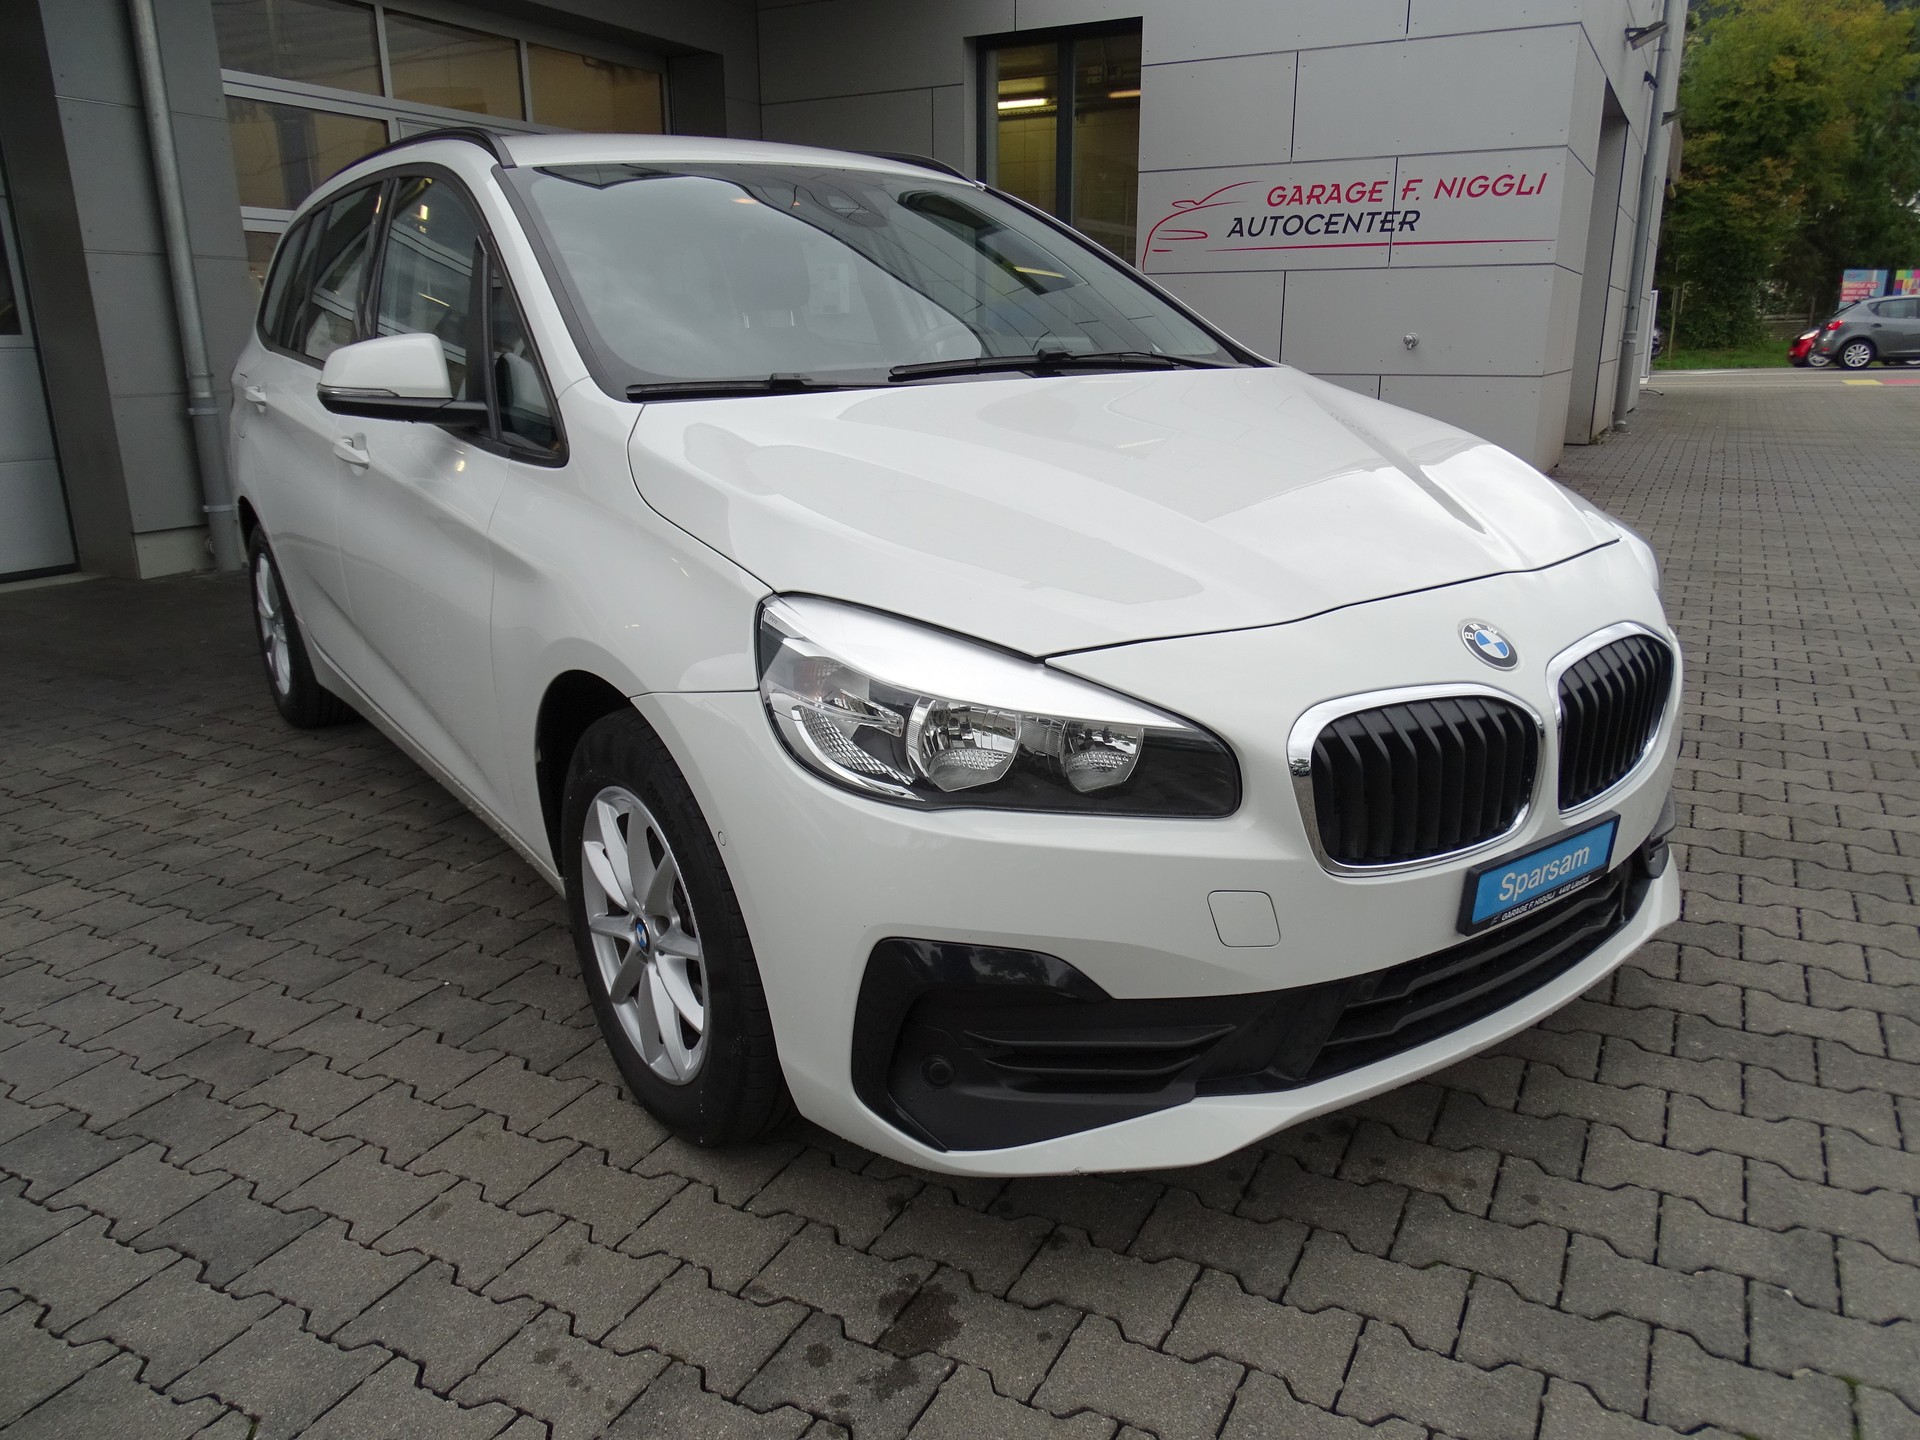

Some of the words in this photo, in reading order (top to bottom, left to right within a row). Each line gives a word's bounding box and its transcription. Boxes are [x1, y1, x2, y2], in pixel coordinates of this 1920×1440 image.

[1266, 181, 1388, 207] GARAGE
[1402, 179, 1423, 200] F.
[1434, 173, 1548, 199] NIGGLI
[1227, 210, 1421, 237] AUTOCENTER
[1499, 846, 1590, 901] Sparsam
[1502, 903, 1529, 920] GARAGE
